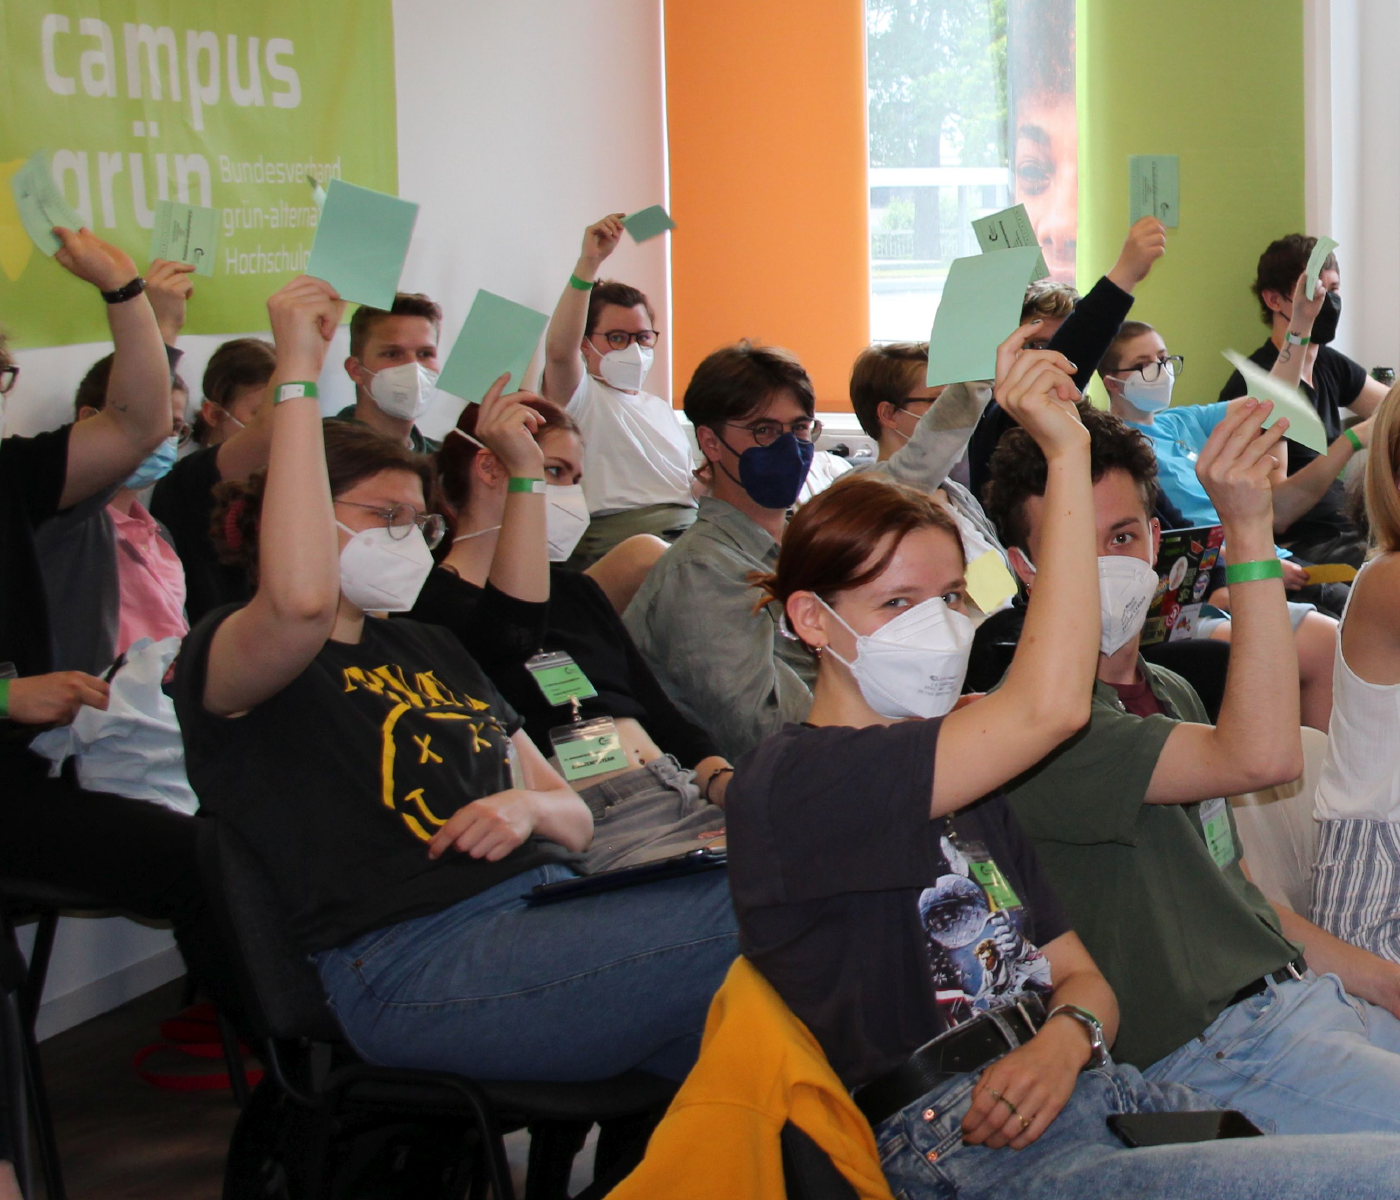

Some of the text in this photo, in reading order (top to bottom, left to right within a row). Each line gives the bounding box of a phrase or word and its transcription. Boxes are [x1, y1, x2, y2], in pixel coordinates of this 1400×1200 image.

[41, 13, 301, 131] campus
[52, 121, 213, 232] grün
[219, 154, 342, 184] Bundesverband
